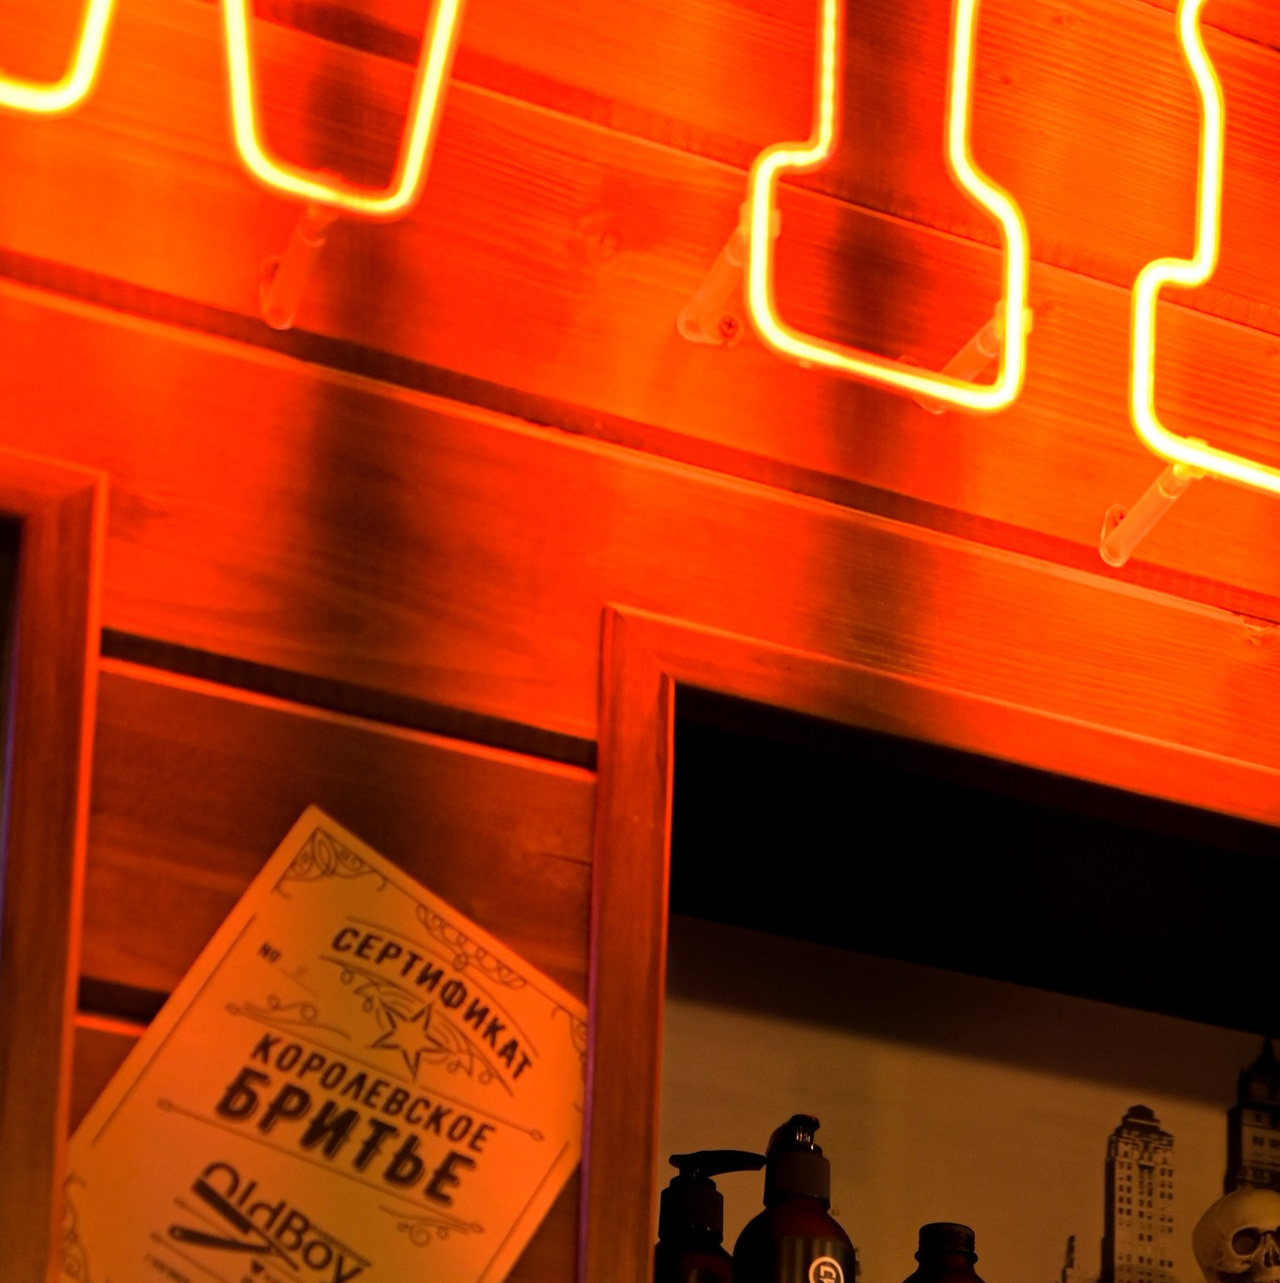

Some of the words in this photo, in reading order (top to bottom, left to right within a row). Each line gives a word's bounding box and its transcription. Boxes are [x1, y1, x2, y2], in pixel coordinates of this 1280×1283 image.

[332, 925, 534, 1082] СЕРТИФИКАТ
[215, 1068, 478, 1206] БРИТЬЕ
[249, 1033, 497, 1153] КОРОЛЕВСКОЕ
